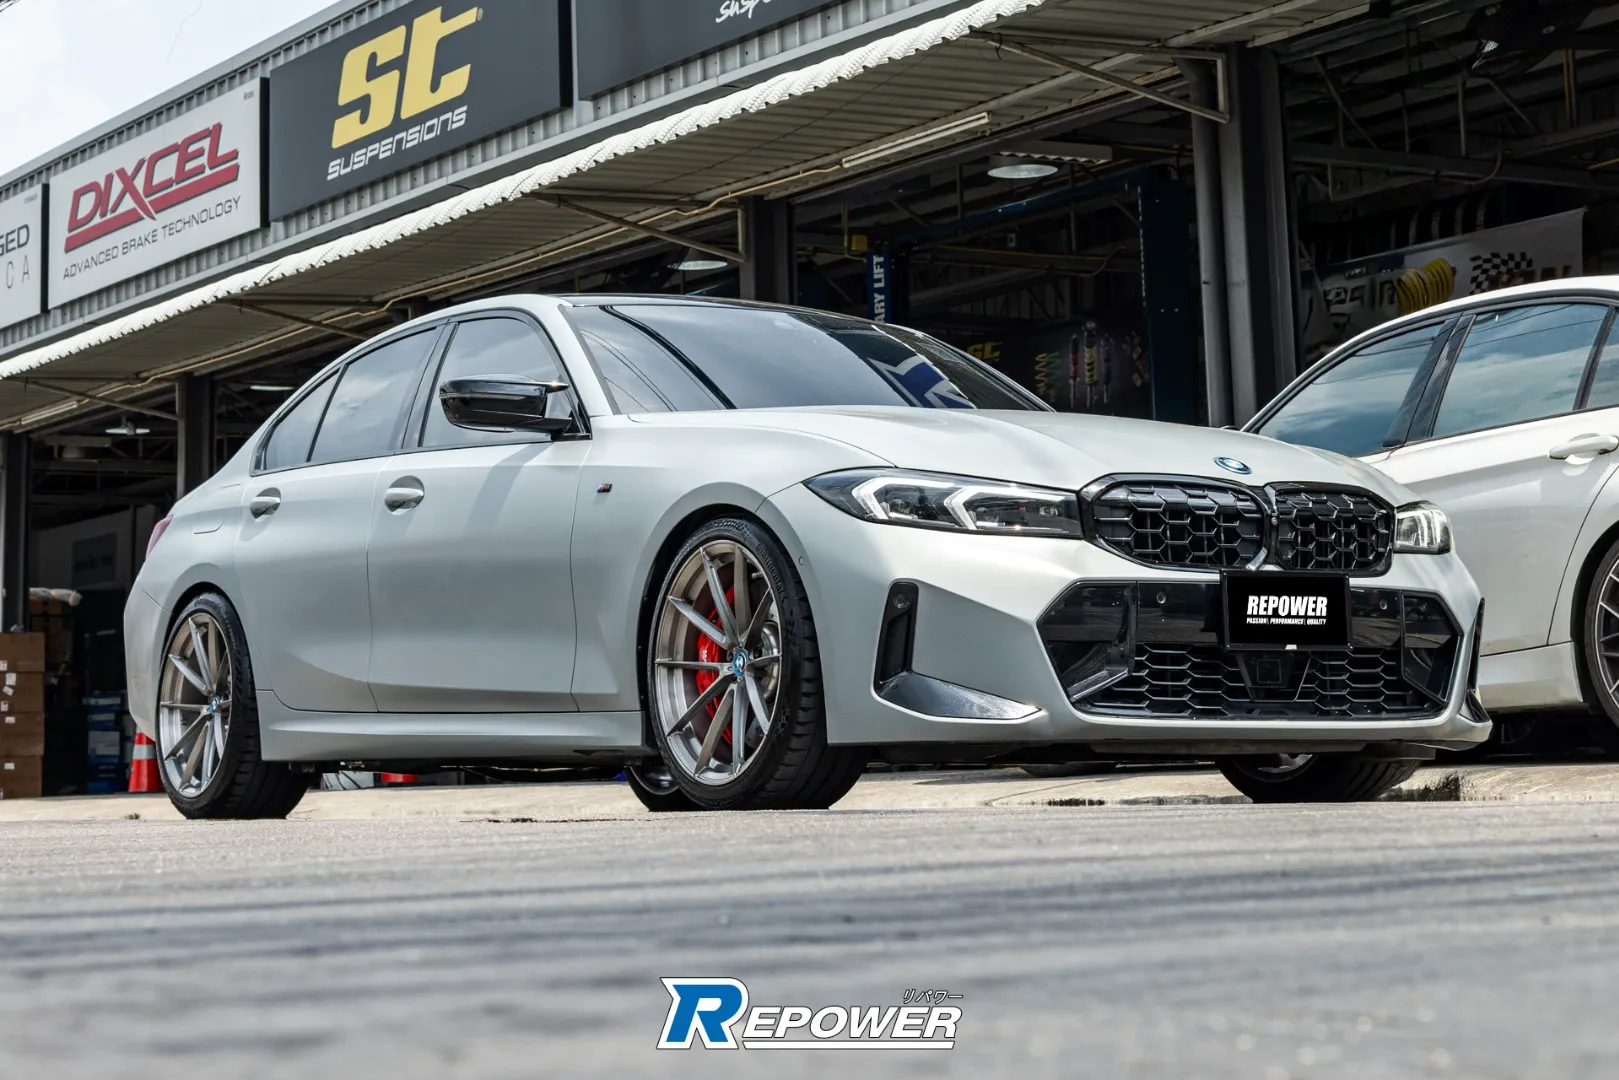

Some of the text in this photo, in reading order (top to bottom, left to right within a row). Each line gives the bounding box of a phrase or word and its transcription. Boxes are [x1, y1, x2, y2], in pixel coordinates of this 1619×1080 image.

[715, 0, 771, 23] susp
[327, 105, 468, 180] SUSPENSIONS
[67, 121, 240, 220] DIXCEL
[63, 196, 241, 280] ADVANCED BRAKE TECHNOLOGY
[872, 255, 885, 288] LIFT
[1246, 595, 1328, 616] REPOWER
